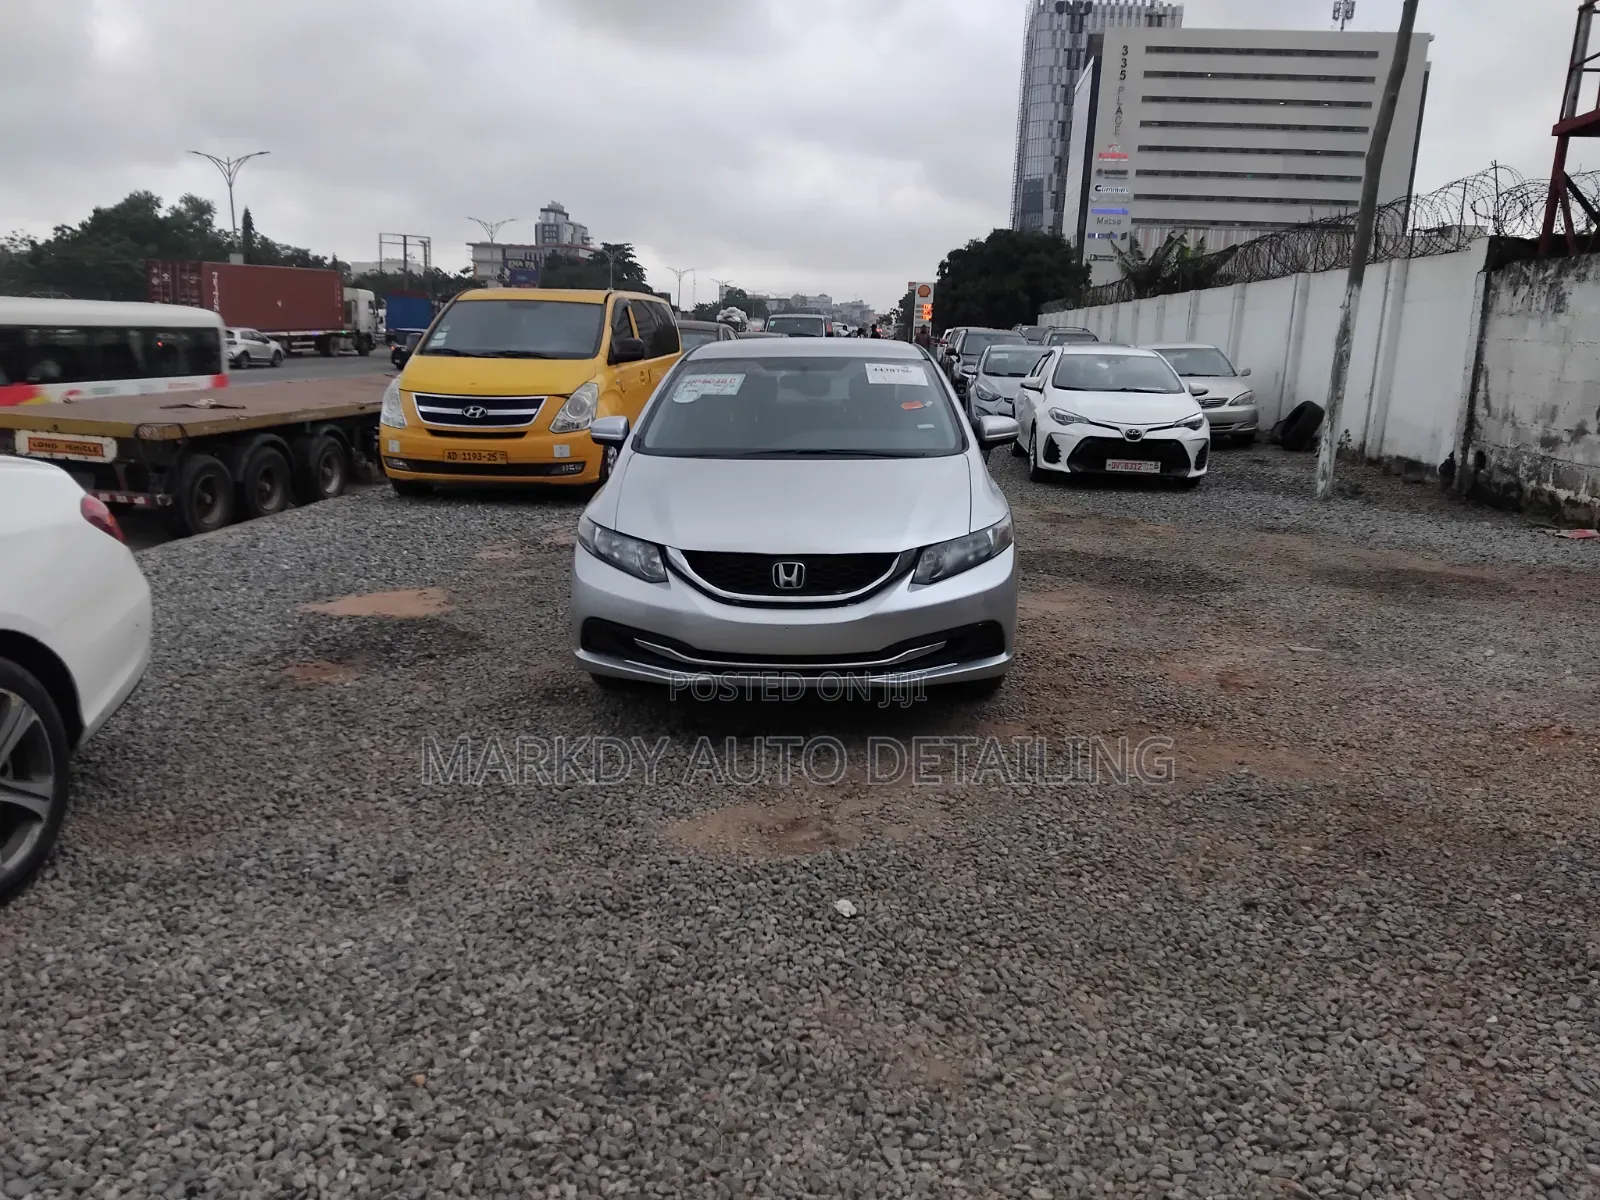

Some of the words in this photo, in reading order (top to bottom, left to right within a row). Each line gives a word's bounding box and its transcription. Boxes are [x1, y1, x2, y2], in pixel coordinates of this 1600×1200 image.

[1119, 44, 1129, 81] 335
[1114, 85, 1125, 135] PLACE
[1096, 217, 1122, 225] Metso
[33, 441, 58, 449] LONG
